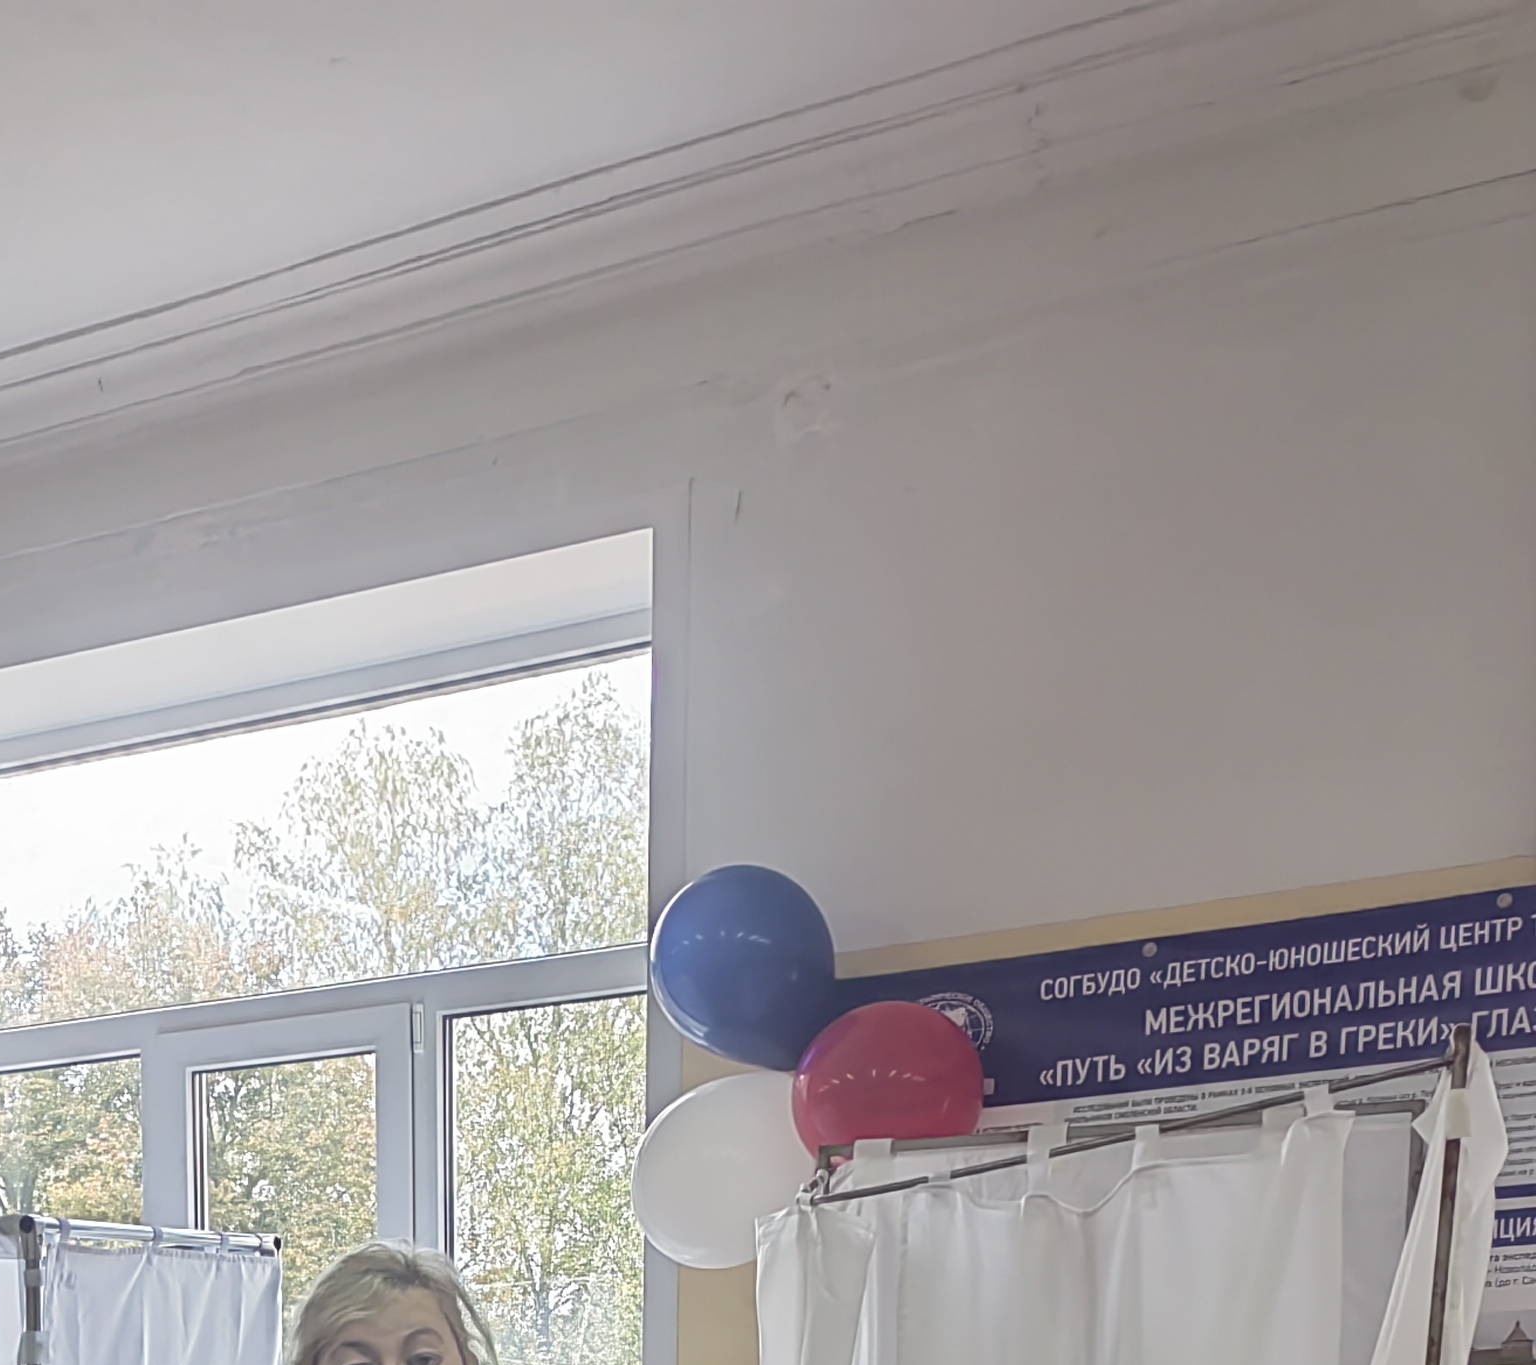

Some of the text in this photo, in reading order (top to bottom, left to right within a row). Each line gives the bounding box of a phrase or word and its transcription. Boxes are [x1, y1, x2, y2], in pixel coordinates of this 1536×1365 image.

[1040, 967, 1141, 1000] СОГБУДО
[1149, 923, 1431, 988] «ДЕТСКО-ЮНОШЕСКИЙ
[1439, 916, 1523, 952] ЦЕНТР
[1145, 970, 1462, 1035] МЕЖРЕГИОНАЛЬНАЯ
[1039, 1006, 1536, 1087] «ПУТЬ «ИЗ ВАРЯГ В ГРЕКИ» ГЛА
